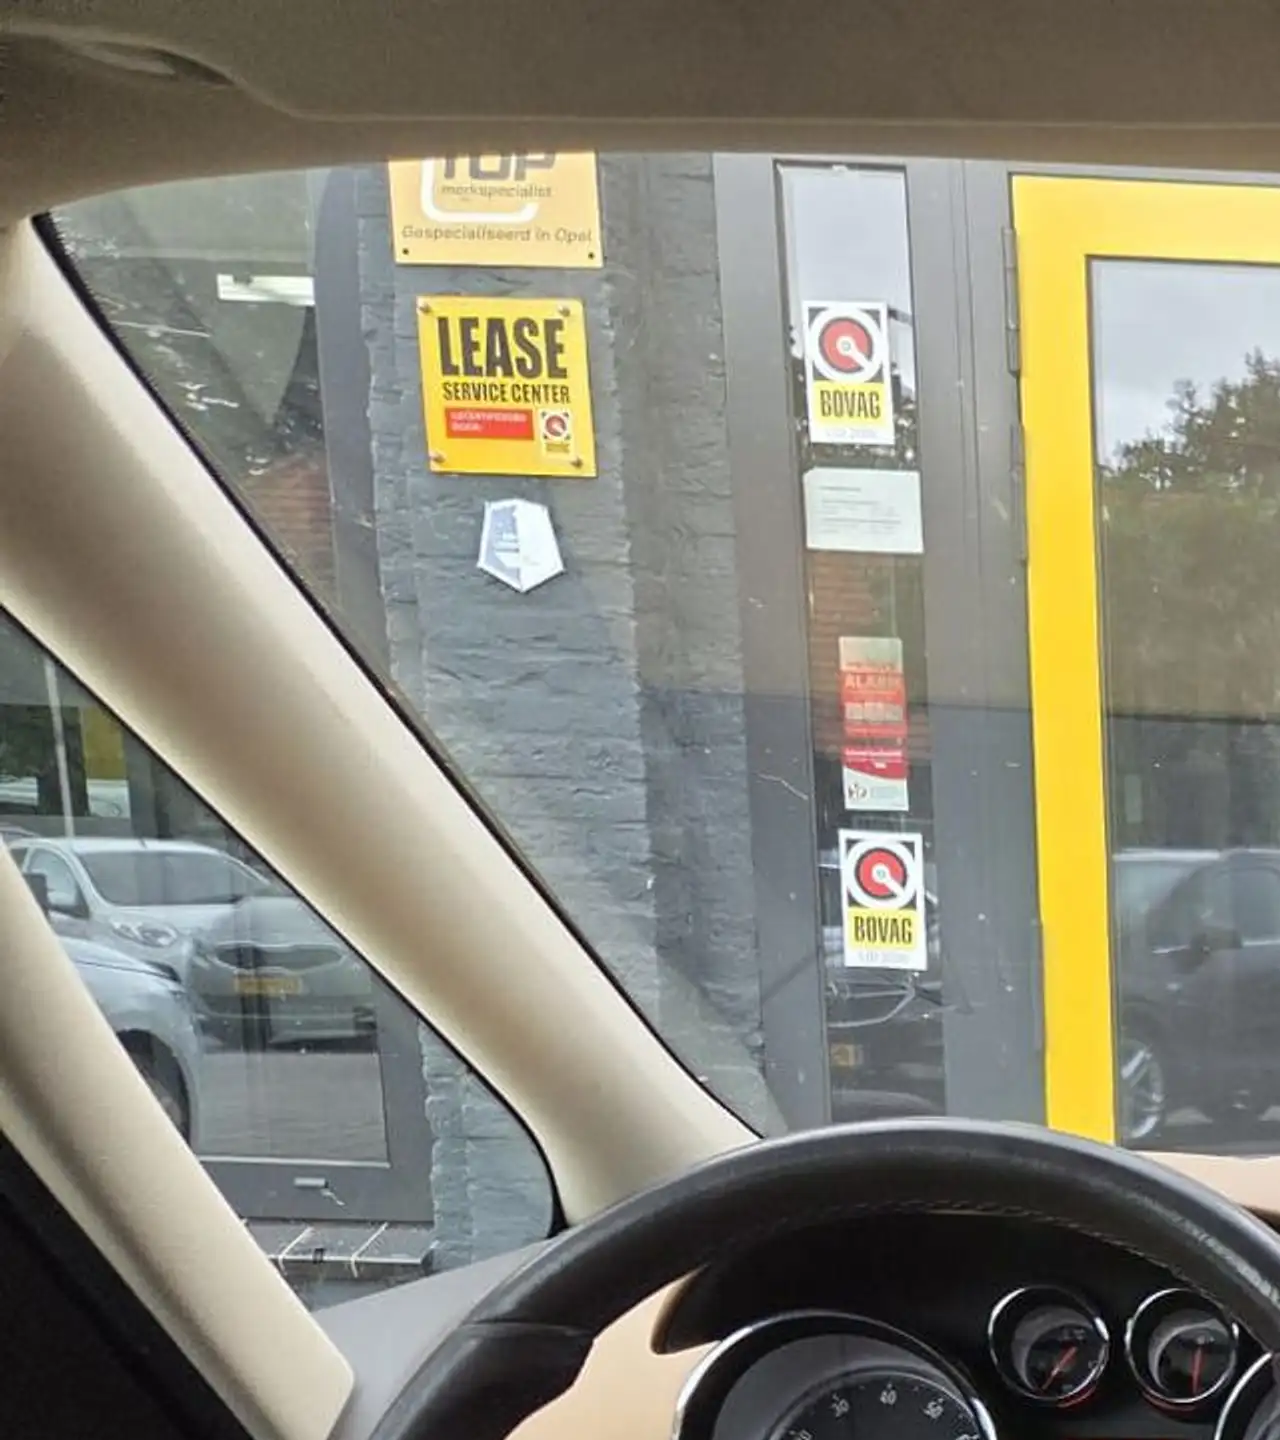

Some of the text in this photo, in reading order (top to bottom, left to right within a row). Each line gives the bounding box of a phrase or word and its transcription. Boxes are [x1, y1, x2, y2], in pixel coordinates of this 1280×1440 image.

[402, 225, 593, 244] Gespecialiseerd in Opel
[437, 316, 568, 379] LEASE
[442, 381, 571, 405] SERVICE CENTER
[820, 389, 881, 420] BOVAG
[854, 915, 913, 945] BOVAG
[831, 1400, 850, 1418] 30
[880, 1389, 897, 1406] 40
